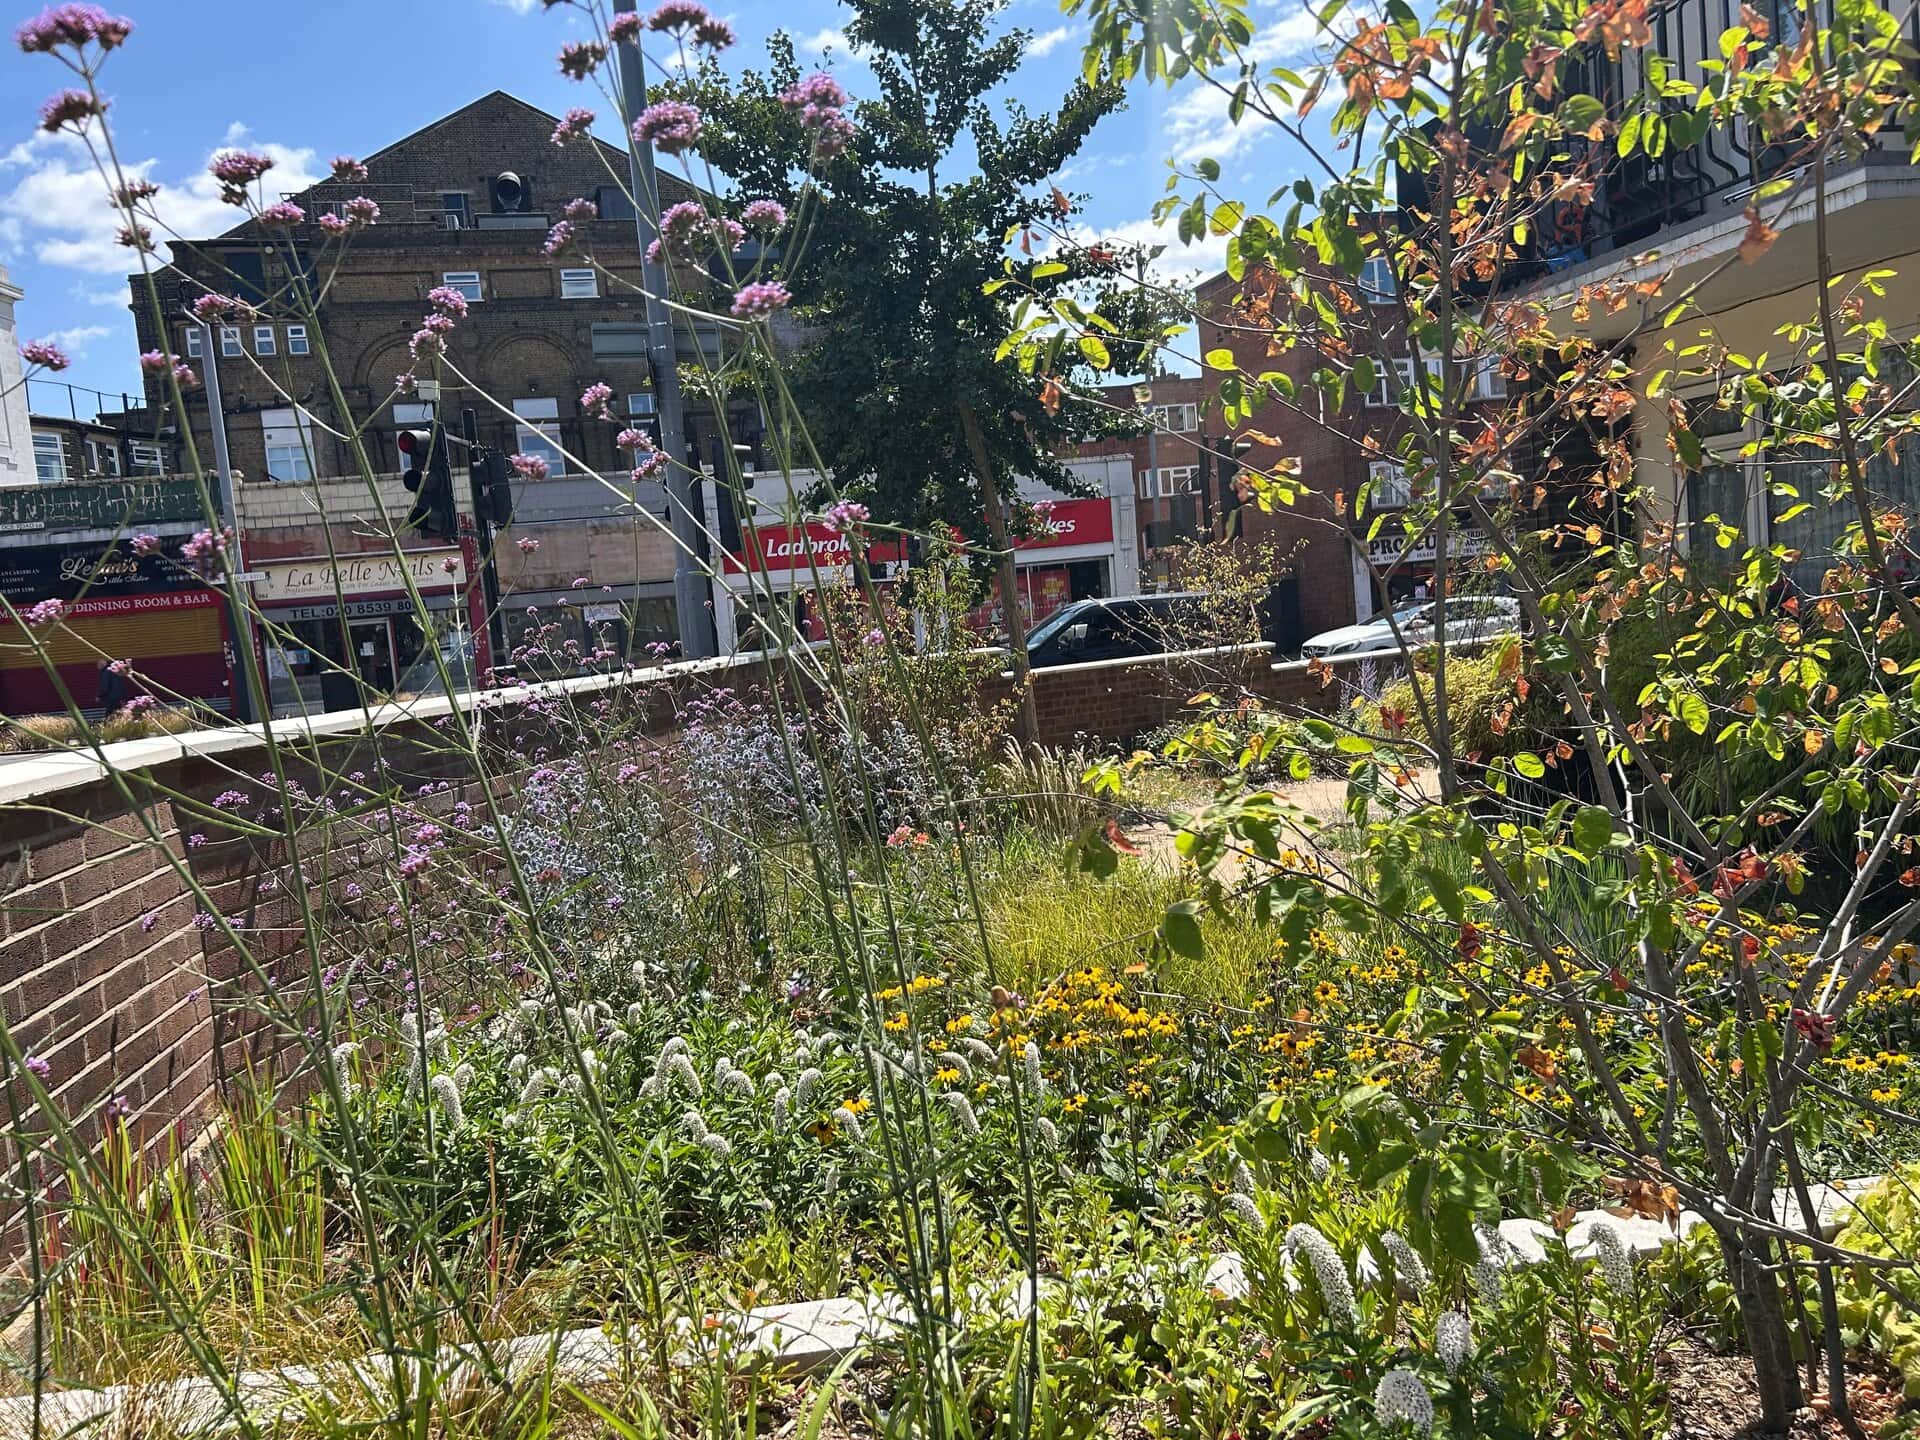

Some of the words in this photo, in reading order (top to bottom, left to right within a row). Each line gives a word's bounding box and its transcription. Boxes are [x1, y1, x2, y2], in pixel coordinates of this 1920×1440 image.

[1040, 516, 1076, 535] kes
[766, 533, 870, 558] Ladbrok
[285, 568, 314, 587] La
[378, 555, 434, 580] Nils
[75, 598, 131, 613] DINNING
[135, 597, 171, 609] ROOM
[174, 596, 182, 606] &
[184, 593, 211, 604] BAR
[357, 603, 392, 614] 8539
